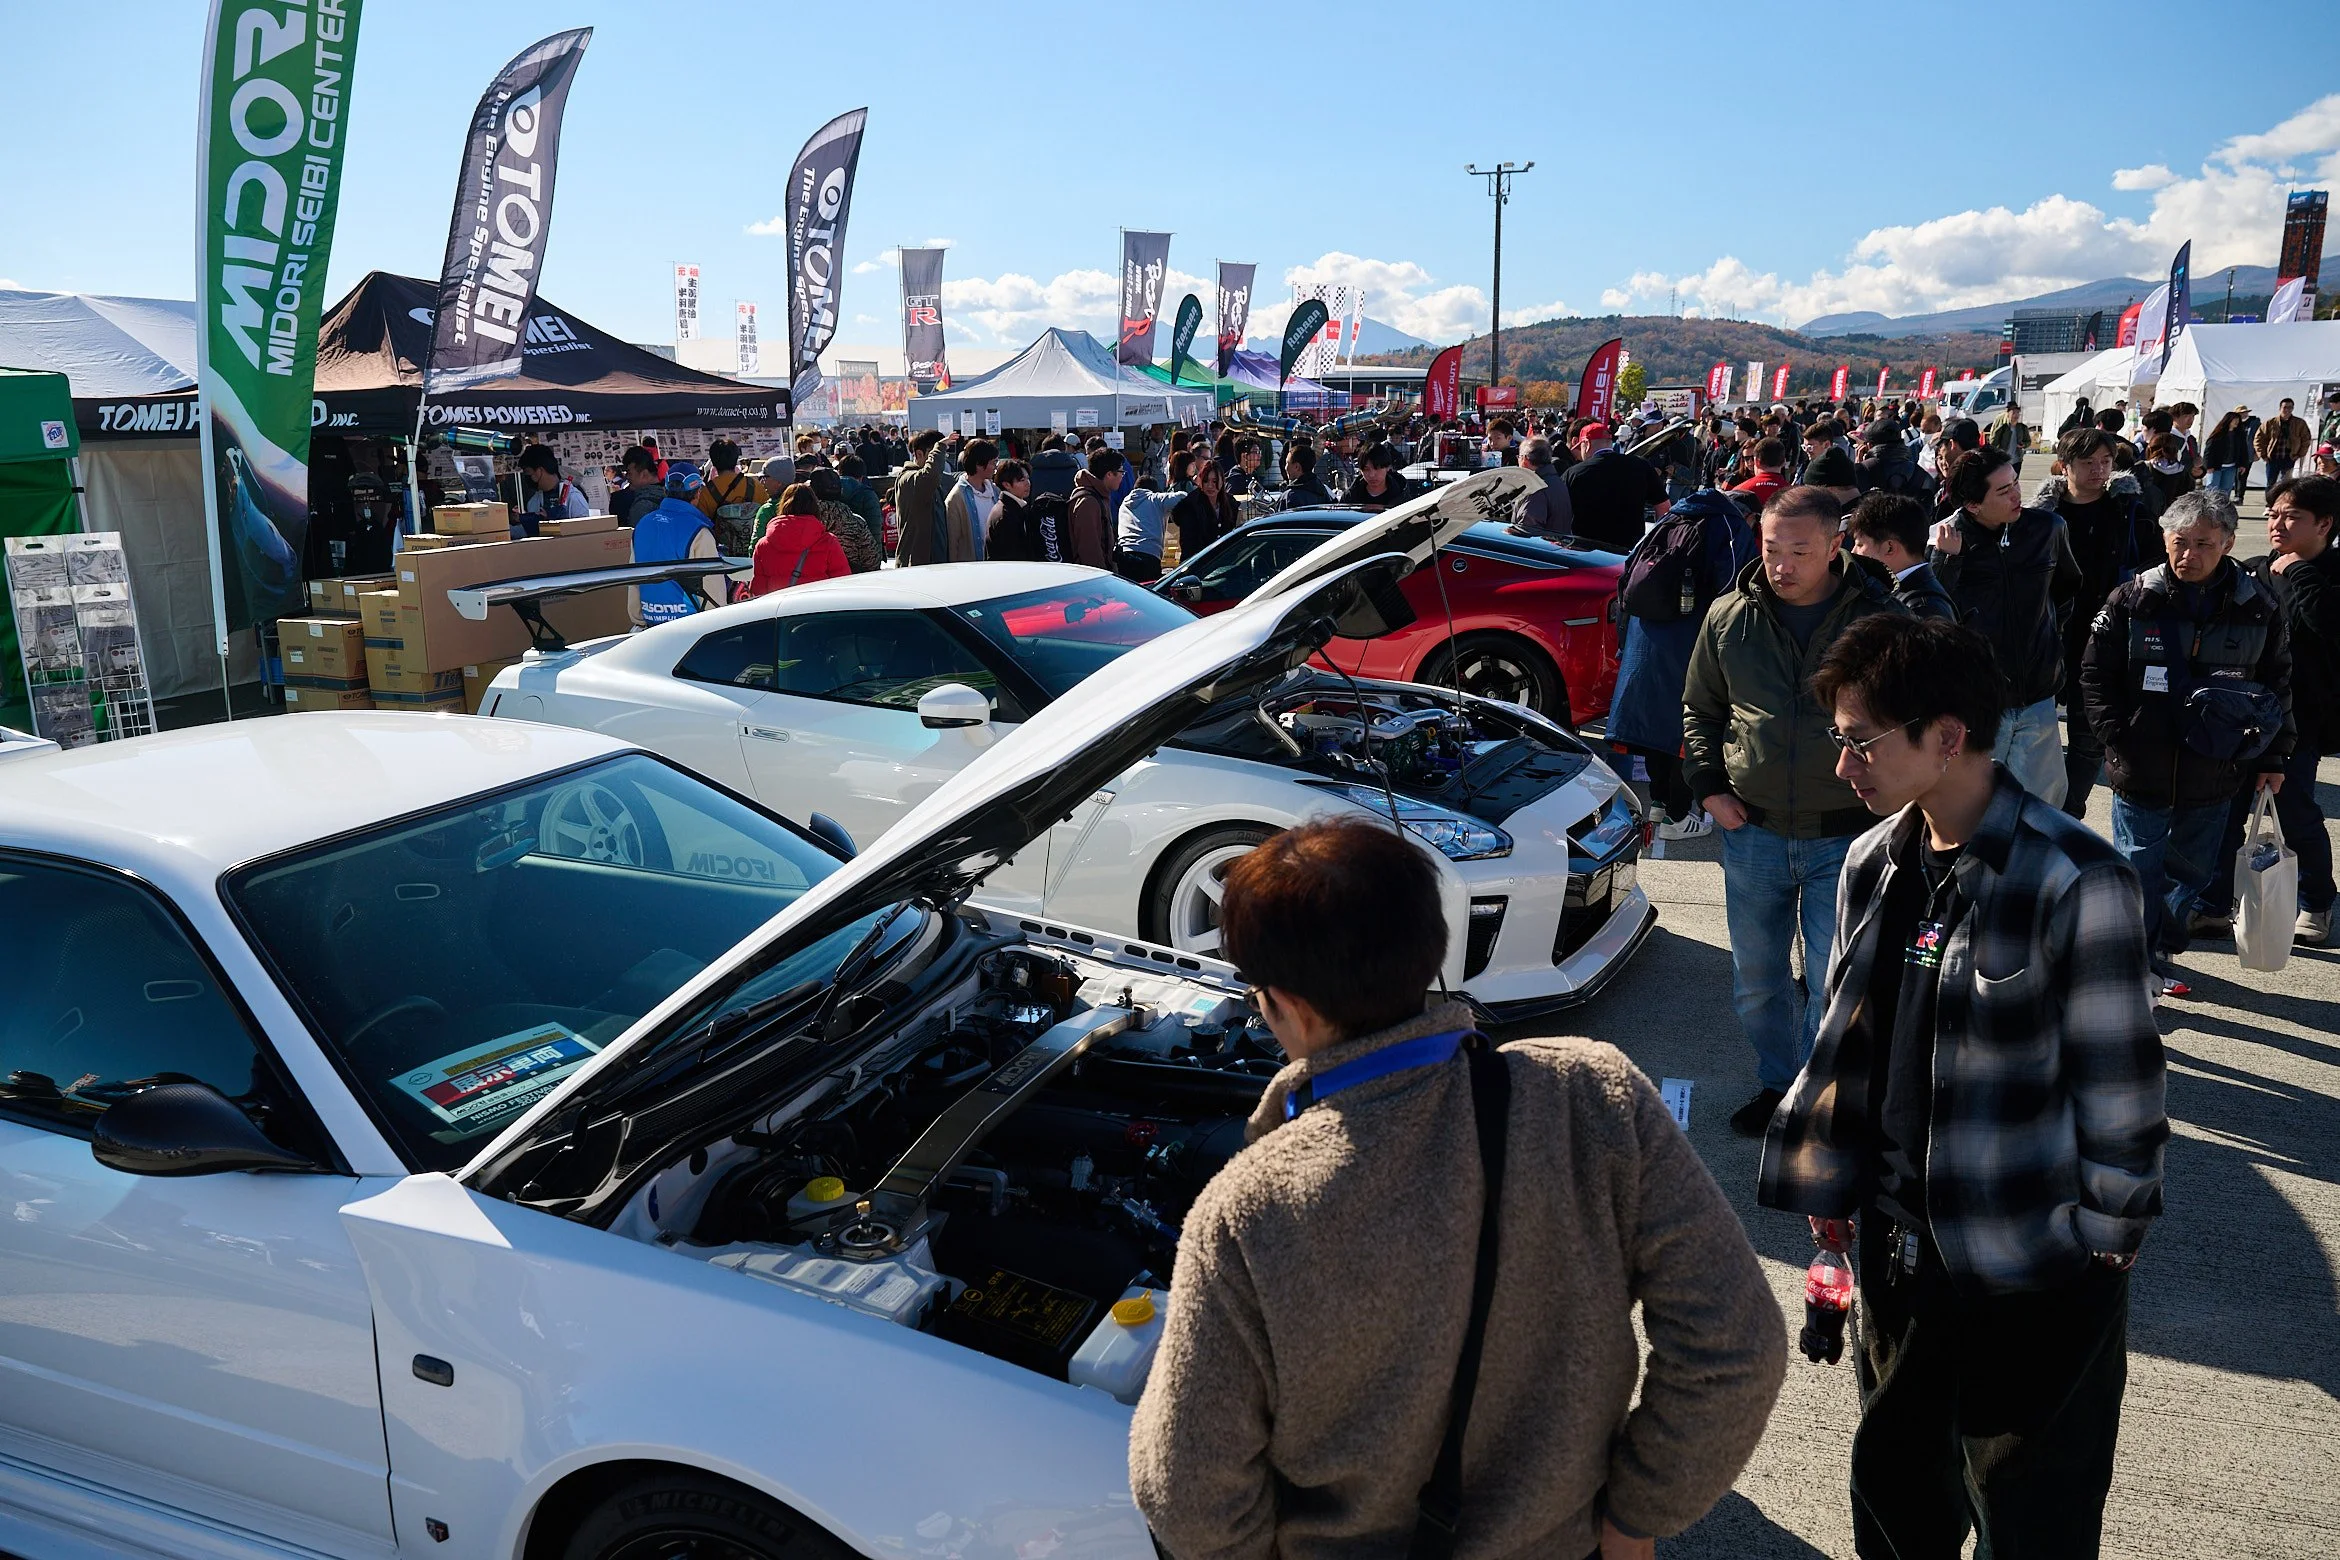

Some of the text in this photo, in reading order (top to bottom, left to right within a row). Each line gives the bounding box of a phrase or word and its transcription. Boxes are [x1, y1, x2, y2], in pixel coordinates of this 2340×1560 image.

[221, 0, 307, 371] MIDOR
[266, 0, 349, 377] MIDORI SEIBI CENTER
[475, 134, 498, 223] Engine
[800, 167, 816, 202] The
[473, 163, 541, 346] TOMEI
[453, 225, 489, 346] Specialist
[908, 307, 942, 327] R
[1122, 316, 1152, 344] R
[1591, 356, 1610, 420] FUEL
[1711, 366, 1723, 395] MOTUL
[1774, 367, 1786, 398] MOTUL
[1833, 368, 1845, 399] MOTUL
[1921, 370, 1933, 398] MOTUL
[416, 404, 592, 426] TOMEI POWERED INC.
[1446, 386, 1455, 416] HEAVY
[98, 403, 184, 432] TOMEI
[330, 412, 360, 427] INC.
[686, 852, 776, 881] MIDORI
[450, 1045, 564, 1096] 展示車両
[470, 1083, 555, 1121] NISMO FESTIVAL
